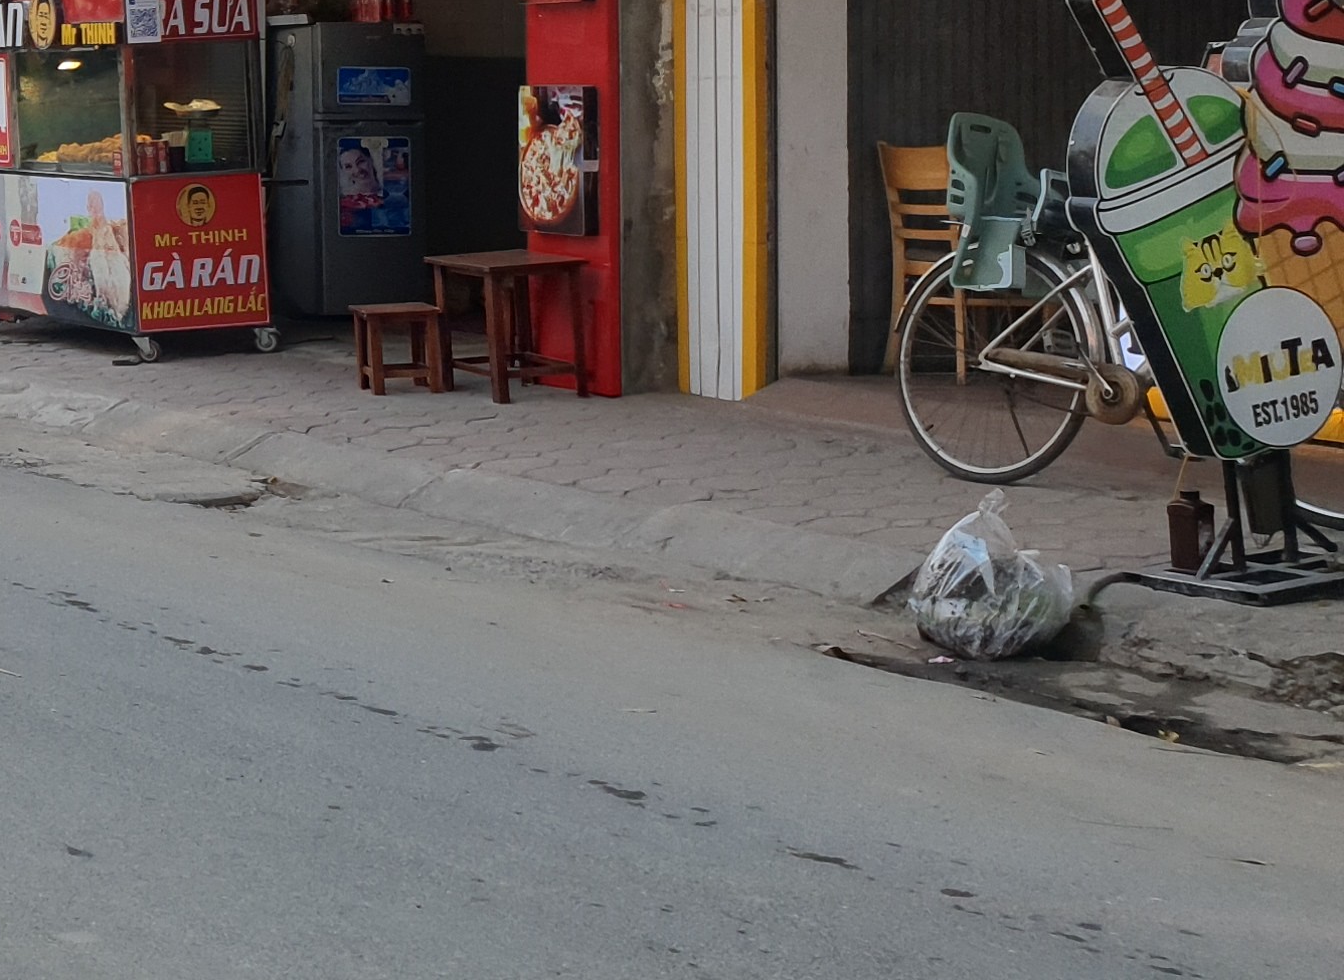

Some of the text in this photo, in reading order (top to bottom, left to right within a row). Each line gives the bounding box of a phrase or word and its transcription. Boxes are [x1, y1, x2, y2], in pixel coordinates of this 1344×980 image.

[62, 23, 77, 45] Mr
[154, 229, 248, 248] Mr. THỊNH
[142, 252, 185, 291] GÀ
[190, 248, 261, 288] RÁN
[142, 286, 266, 320] KHOAI LANG LẮC
